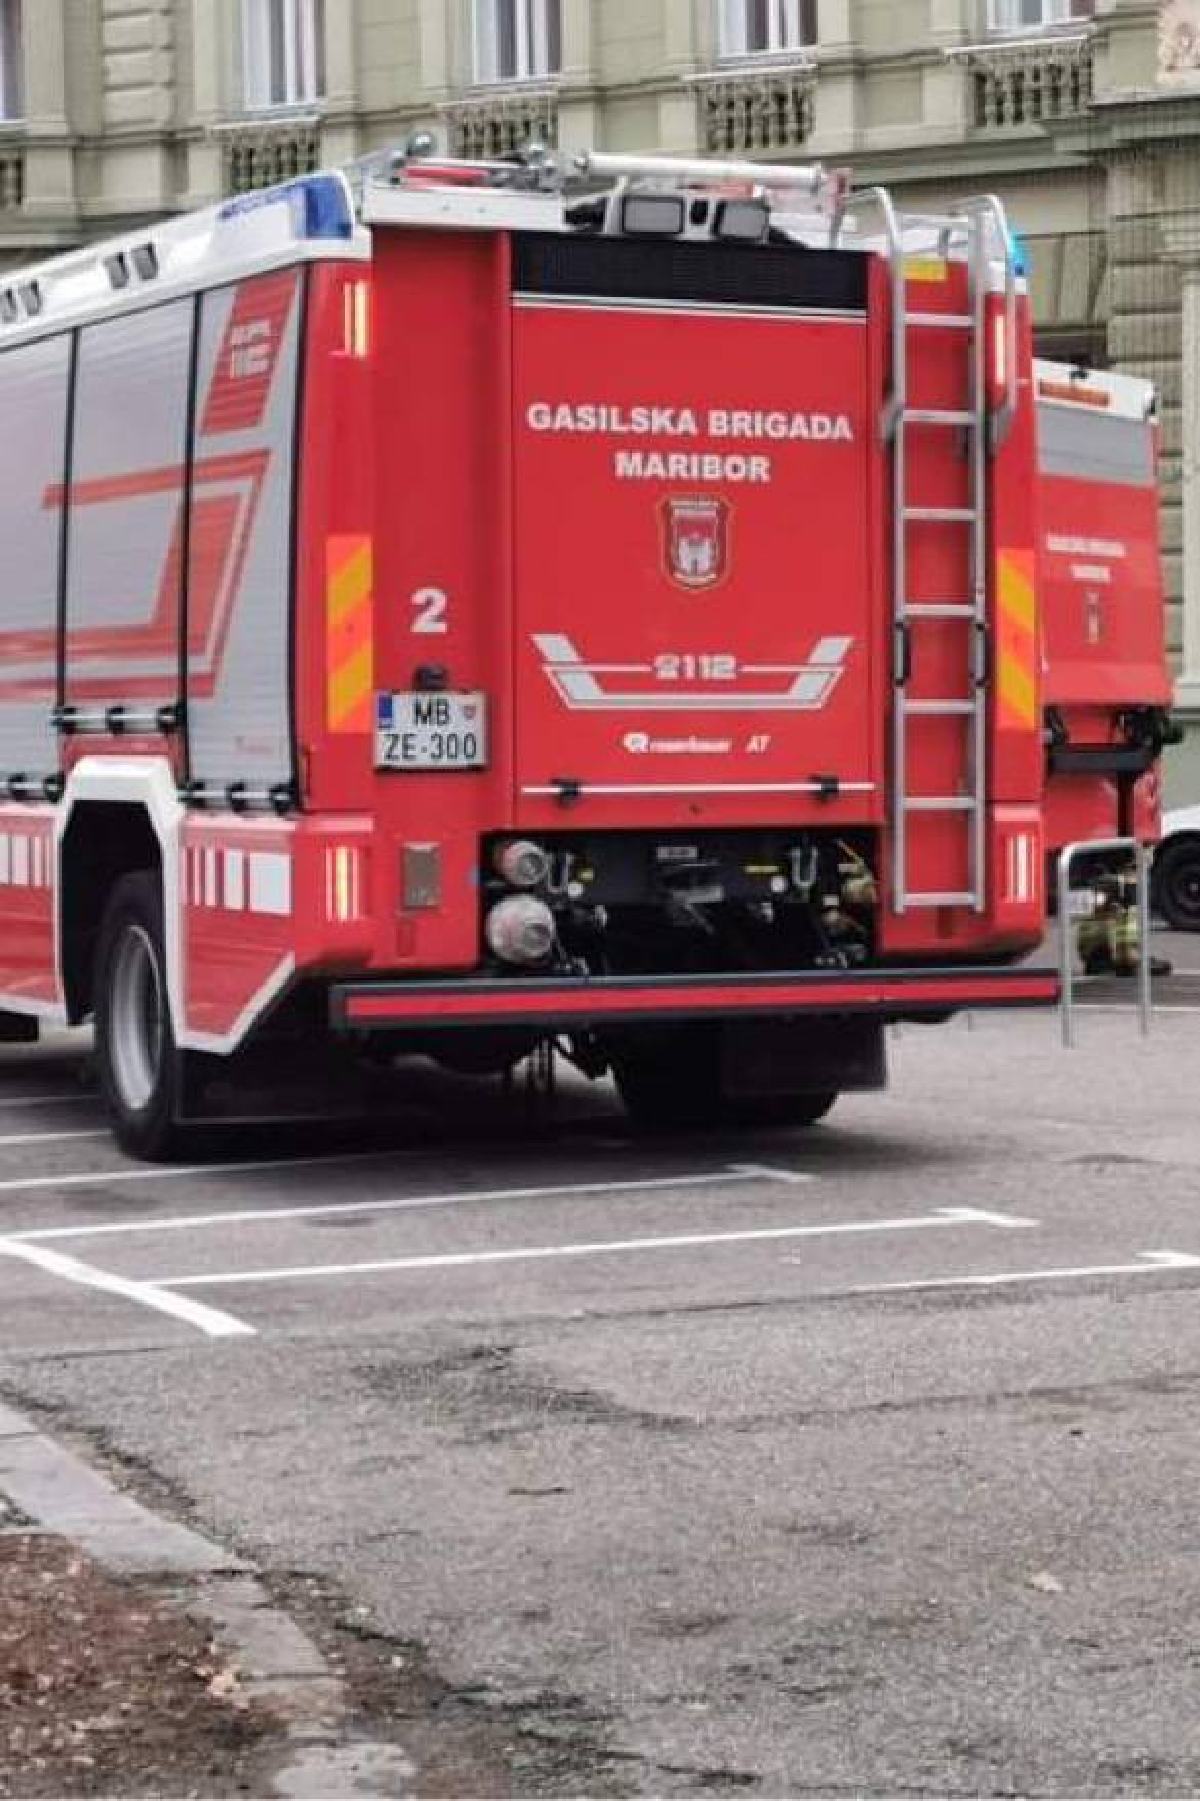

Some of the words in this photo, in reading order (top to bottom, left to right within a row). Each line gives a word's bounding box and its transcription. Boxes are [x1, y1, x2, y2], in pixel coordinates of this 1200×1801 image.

[527, 402, 698, 436] GASILSKA
[707, 409, 854, 440] BRIGADA
[614, 451, 771, 483] MARIBOR
[410, 587, 447, 633] 2
[413, 698, 450, 727] MB
[383, 731, 477, 761] ZE-300
